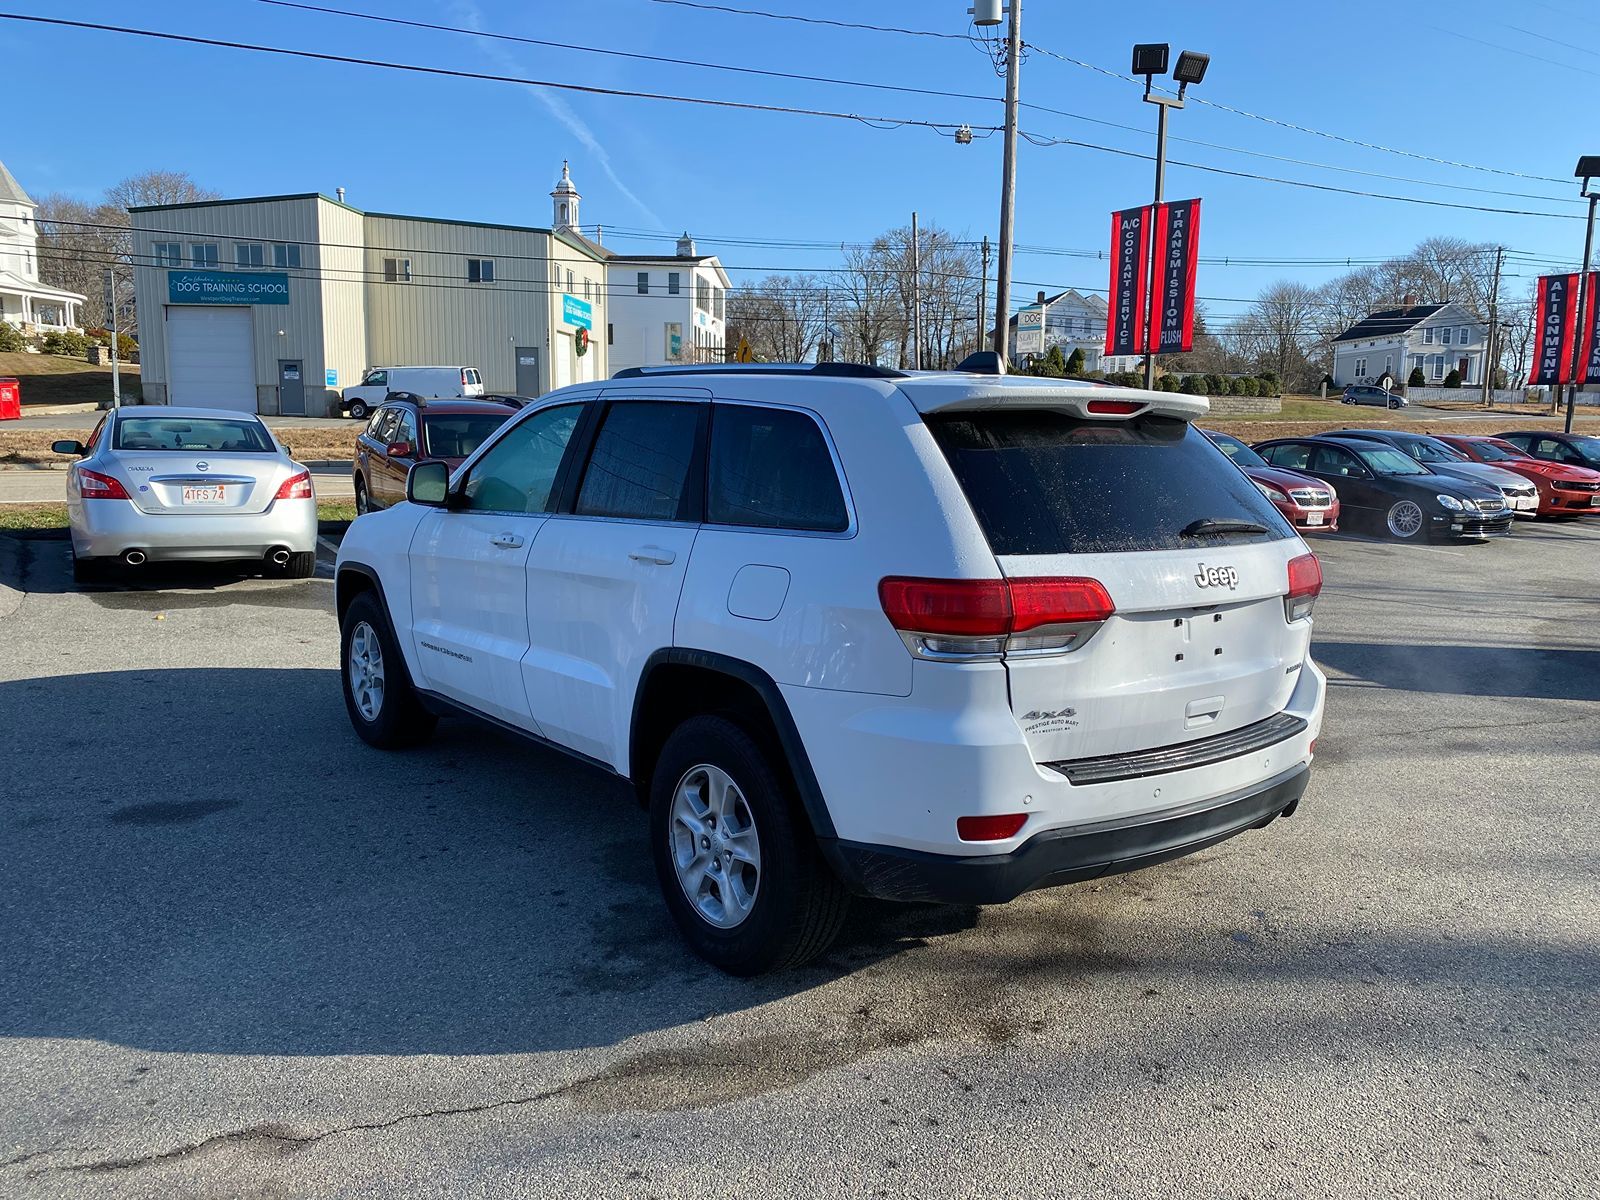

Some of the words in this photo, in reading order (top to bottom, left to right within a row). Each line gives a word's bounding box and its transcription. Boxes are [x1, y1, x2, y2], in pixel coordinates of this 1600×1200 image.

[1121, 218, 1140, 230] A/C
[1123, 231, 1135, 287] COOLANT
[1166, 209, 1185, 327] TRANSMISSION
[177, 282, 200, 292] DOG
[202, 283, 245, 293] TRAINING
[247, 283, 288, 293] SCHOOL
[1024, 313, 1041, 323] DOG
[1119, 290, 1132, 345] SERVICE
[1160, 329, 1182, 344] FLUSH
[1543, 281, 1562, 379] ALIGNMENT
[184, 490, 209, 500] 4TFS
[211, 490, 225, 500] 74
[1194, 562, 1239, 591] Jeep
[1025, 721, 1050, 732] PRESTIGE
